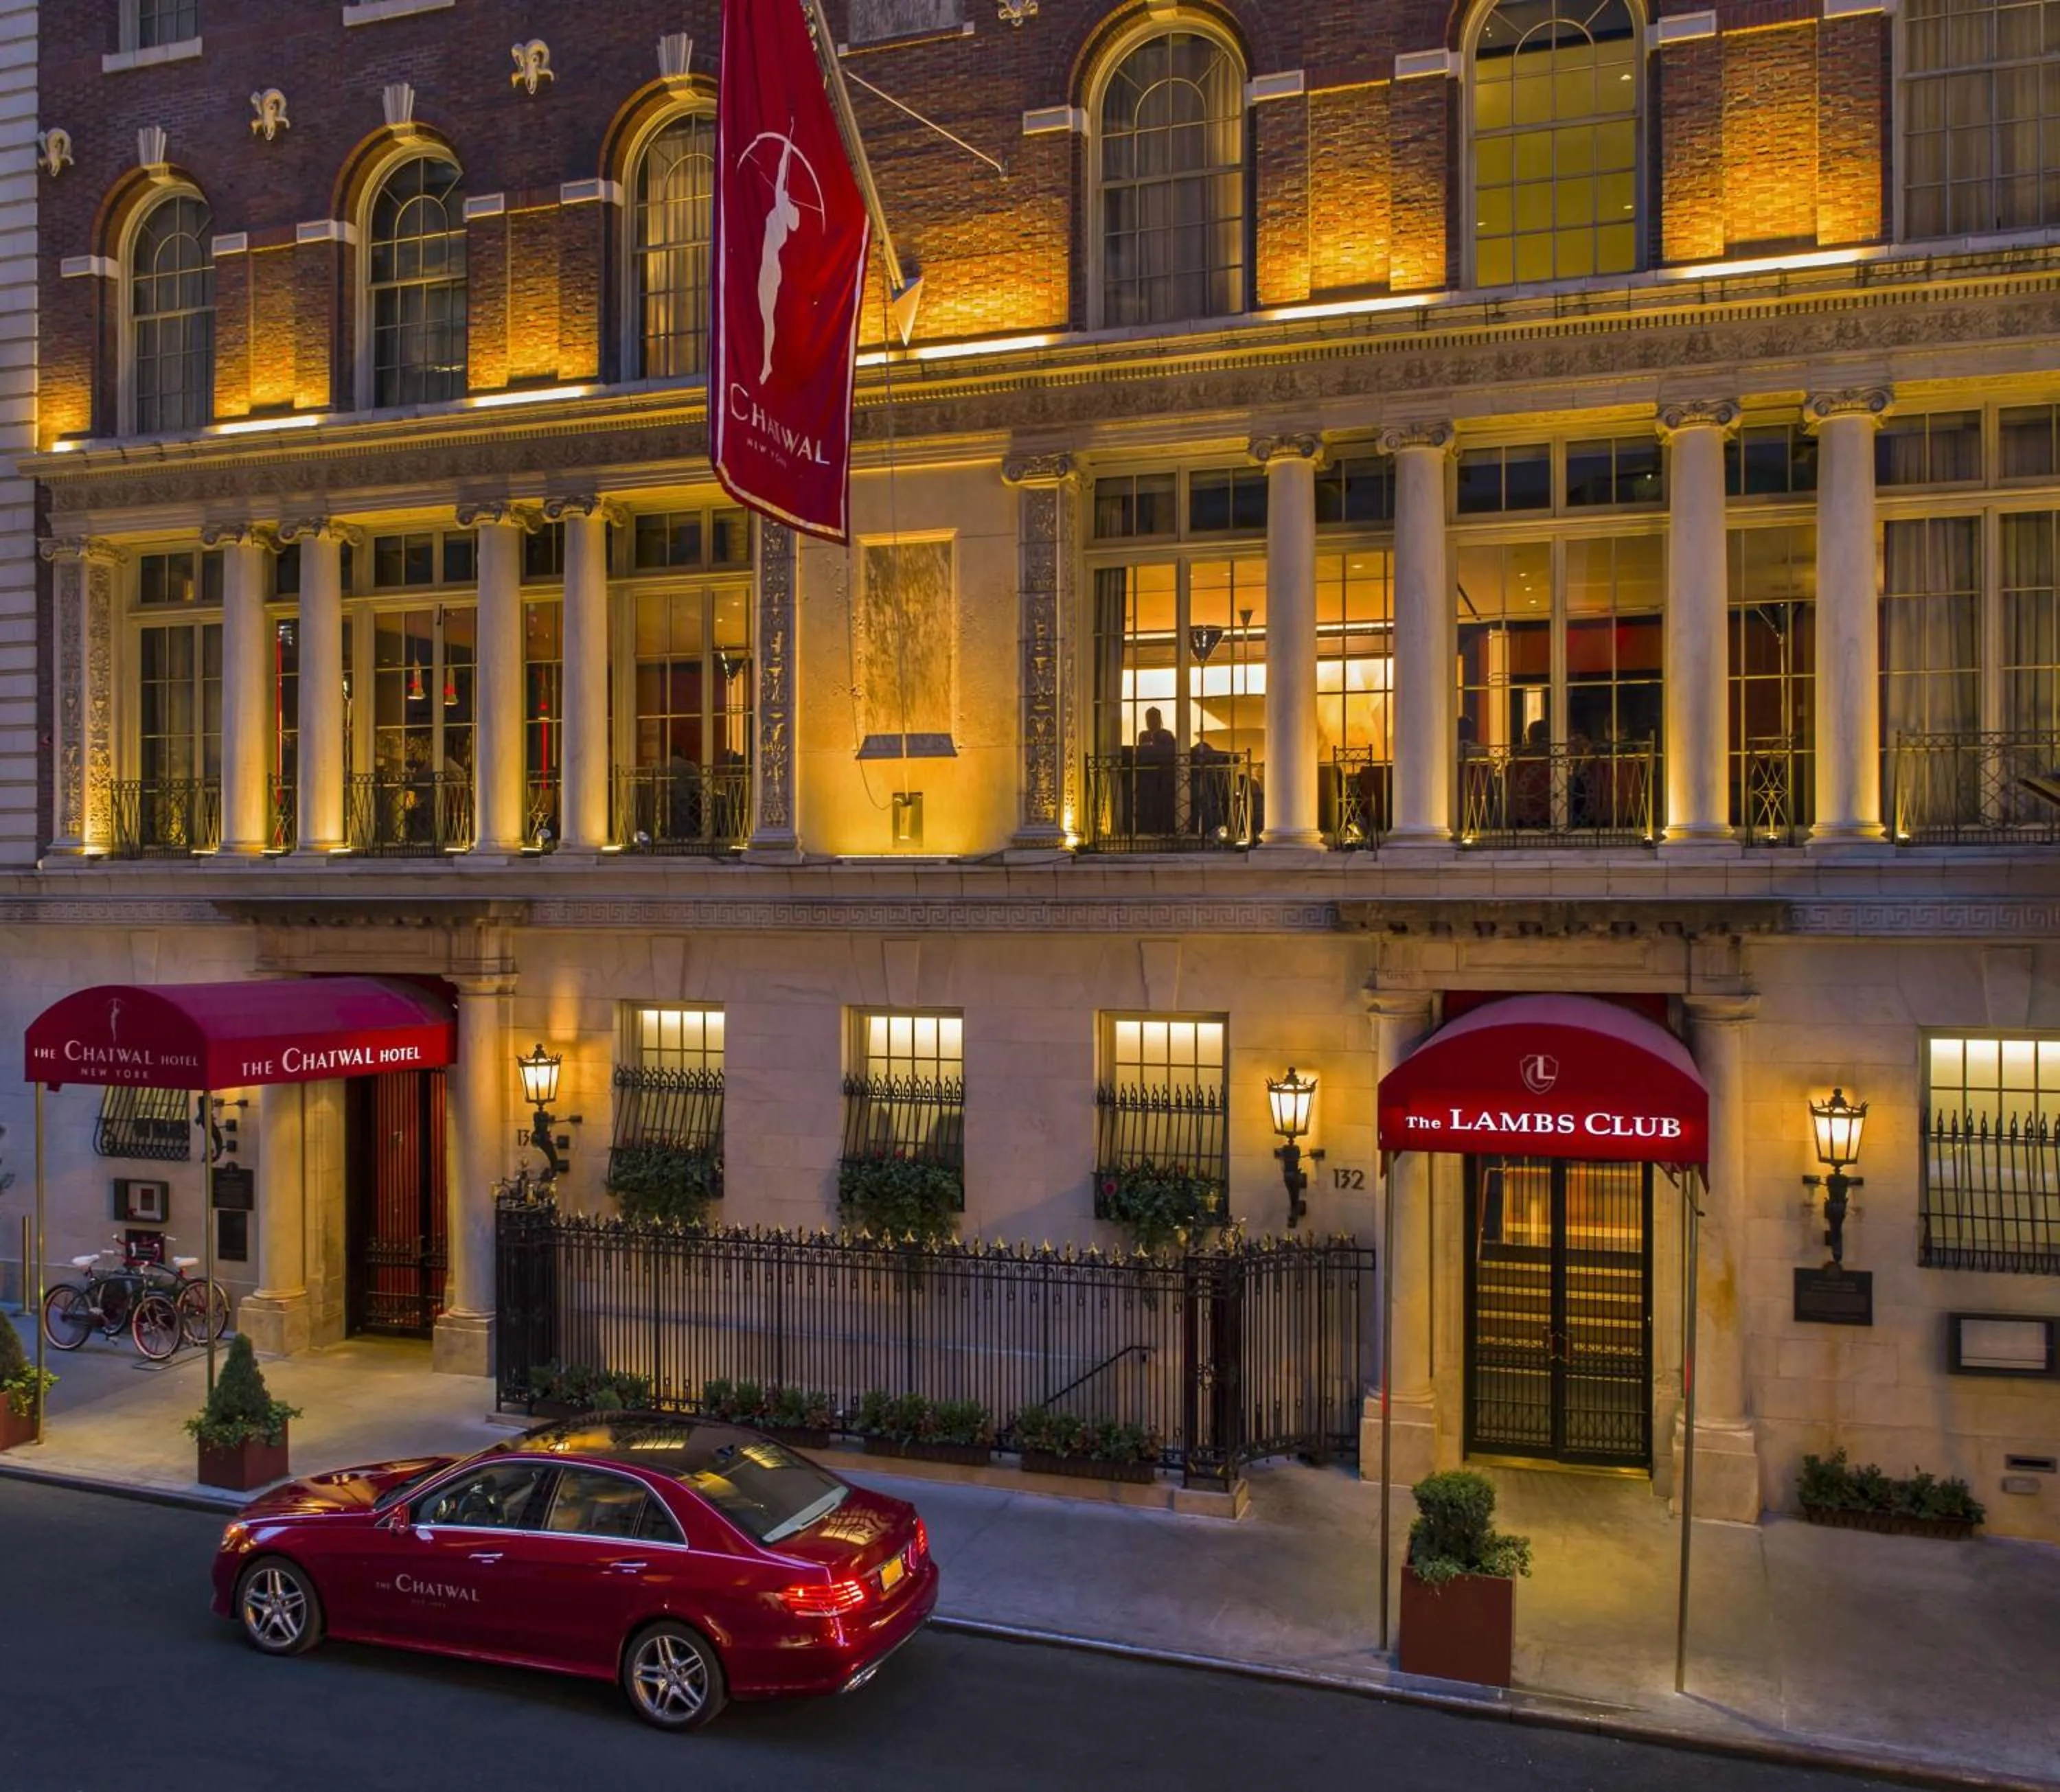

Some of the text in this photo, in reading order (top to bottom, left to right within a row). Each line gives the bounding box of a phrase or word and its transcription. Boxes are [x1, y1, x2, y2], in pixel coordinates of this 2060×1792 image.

[730, 383, 830, 465] CHATWAL
[34, 1040, 198, 1066] THE CHATWAL HOTEL
[242, 1046, 422, 1077] THE CHATWAL HOTEL
[80, 1068, 150, 1079] NEW YORK
[1406, 1109, 1682, 1138] The LAMBS CLUB
[1333, 1169, 1364, 1191] 132
[396, 1574, 480, 1602] CHATWAL
